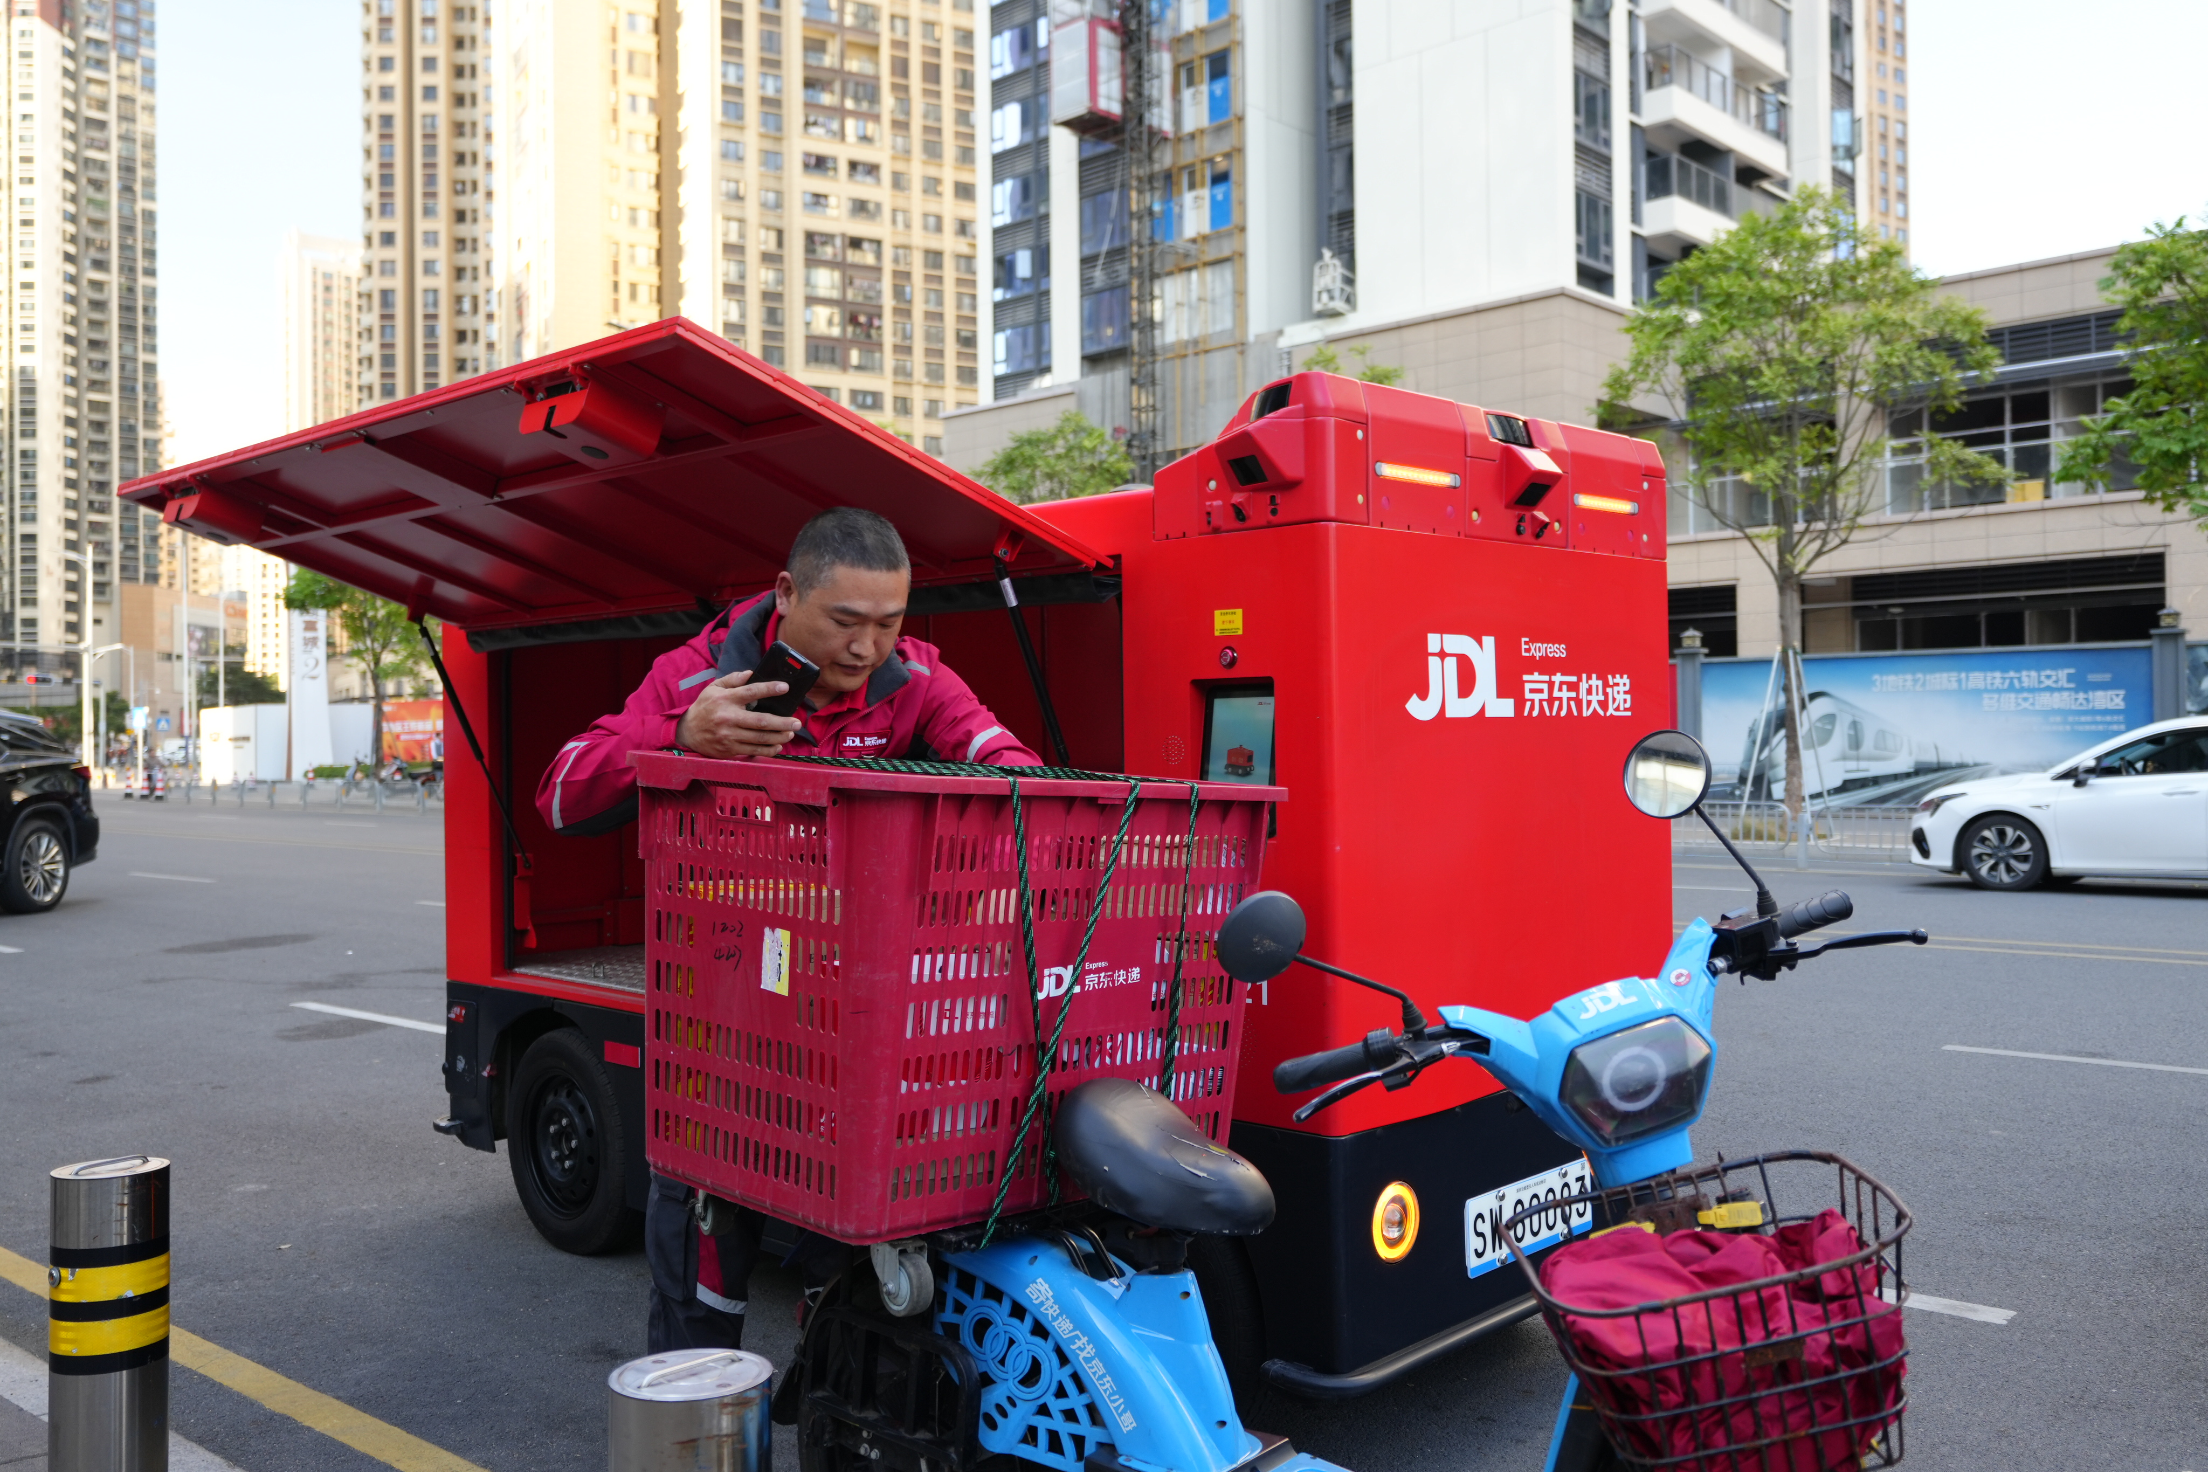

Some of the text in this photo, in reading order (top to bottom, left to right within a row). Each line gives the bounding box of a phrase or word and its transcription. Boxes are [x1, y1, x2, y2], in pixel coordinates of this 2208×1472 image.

[1521, 637, 1567, 660] Express
[1405, 633, 1515, 721] JDL
[1522, 672, 1632, 717] 京东快递
[843, 736, 864, 747] JDL
[1084, 966, 1141, 991] 京东快递
[1085, 961, 1109, 970] Express
[1038, 964, 1081, 1001] JDL
[1580, 986, 1639, 1019] JDL
